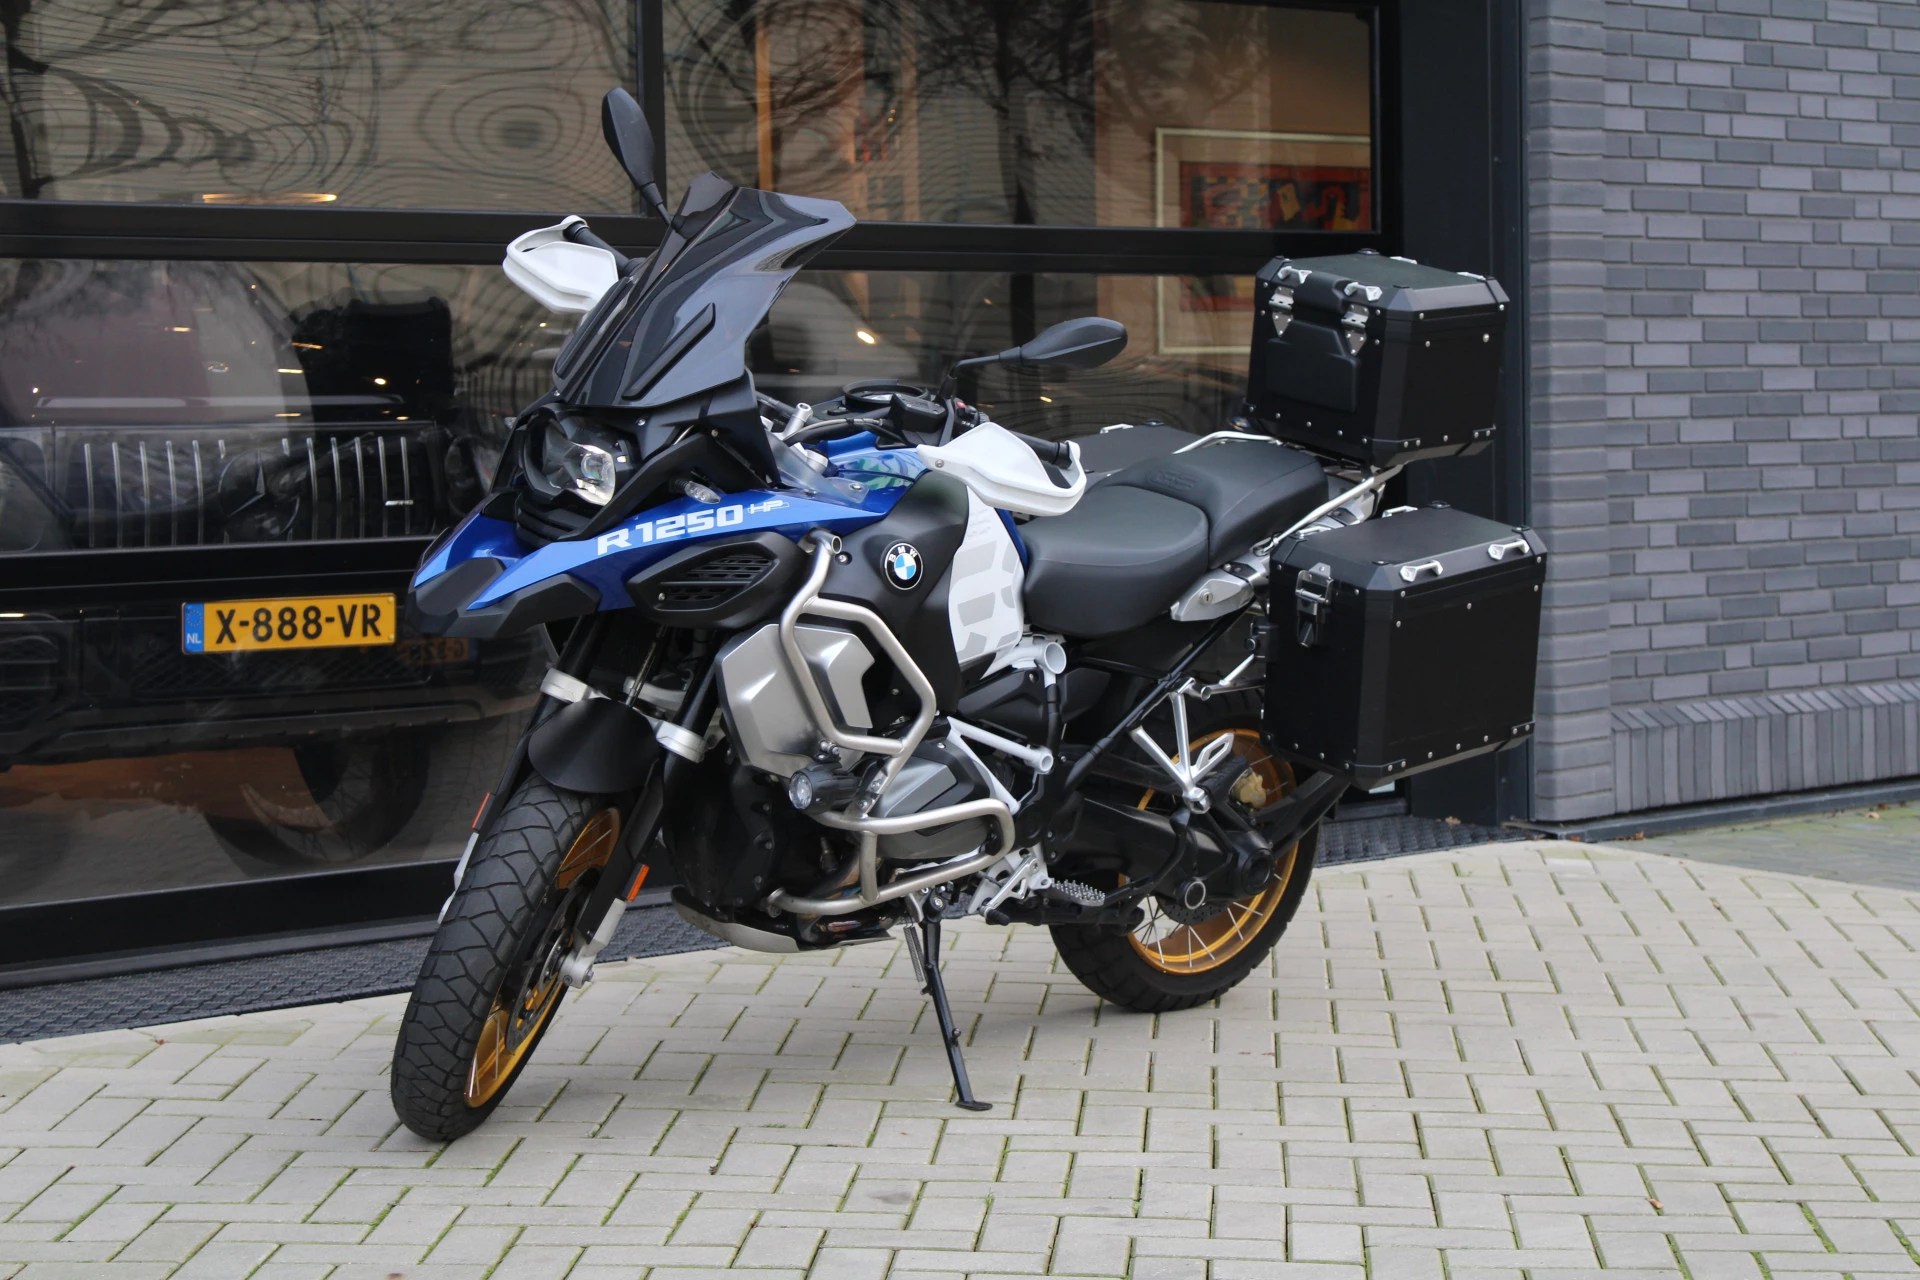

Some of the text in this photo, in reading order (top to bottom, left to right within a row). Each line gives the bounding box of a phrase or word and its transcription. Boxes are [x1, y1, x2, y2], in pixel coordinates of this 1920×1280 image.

[597, 518, 633, 556] R
[635, 504, 744, 543] 1250
[888, 545, 918, 563] BMW
[186, 633, 202, 645] NL
[215, 603, 382, 645] X-888-VR
